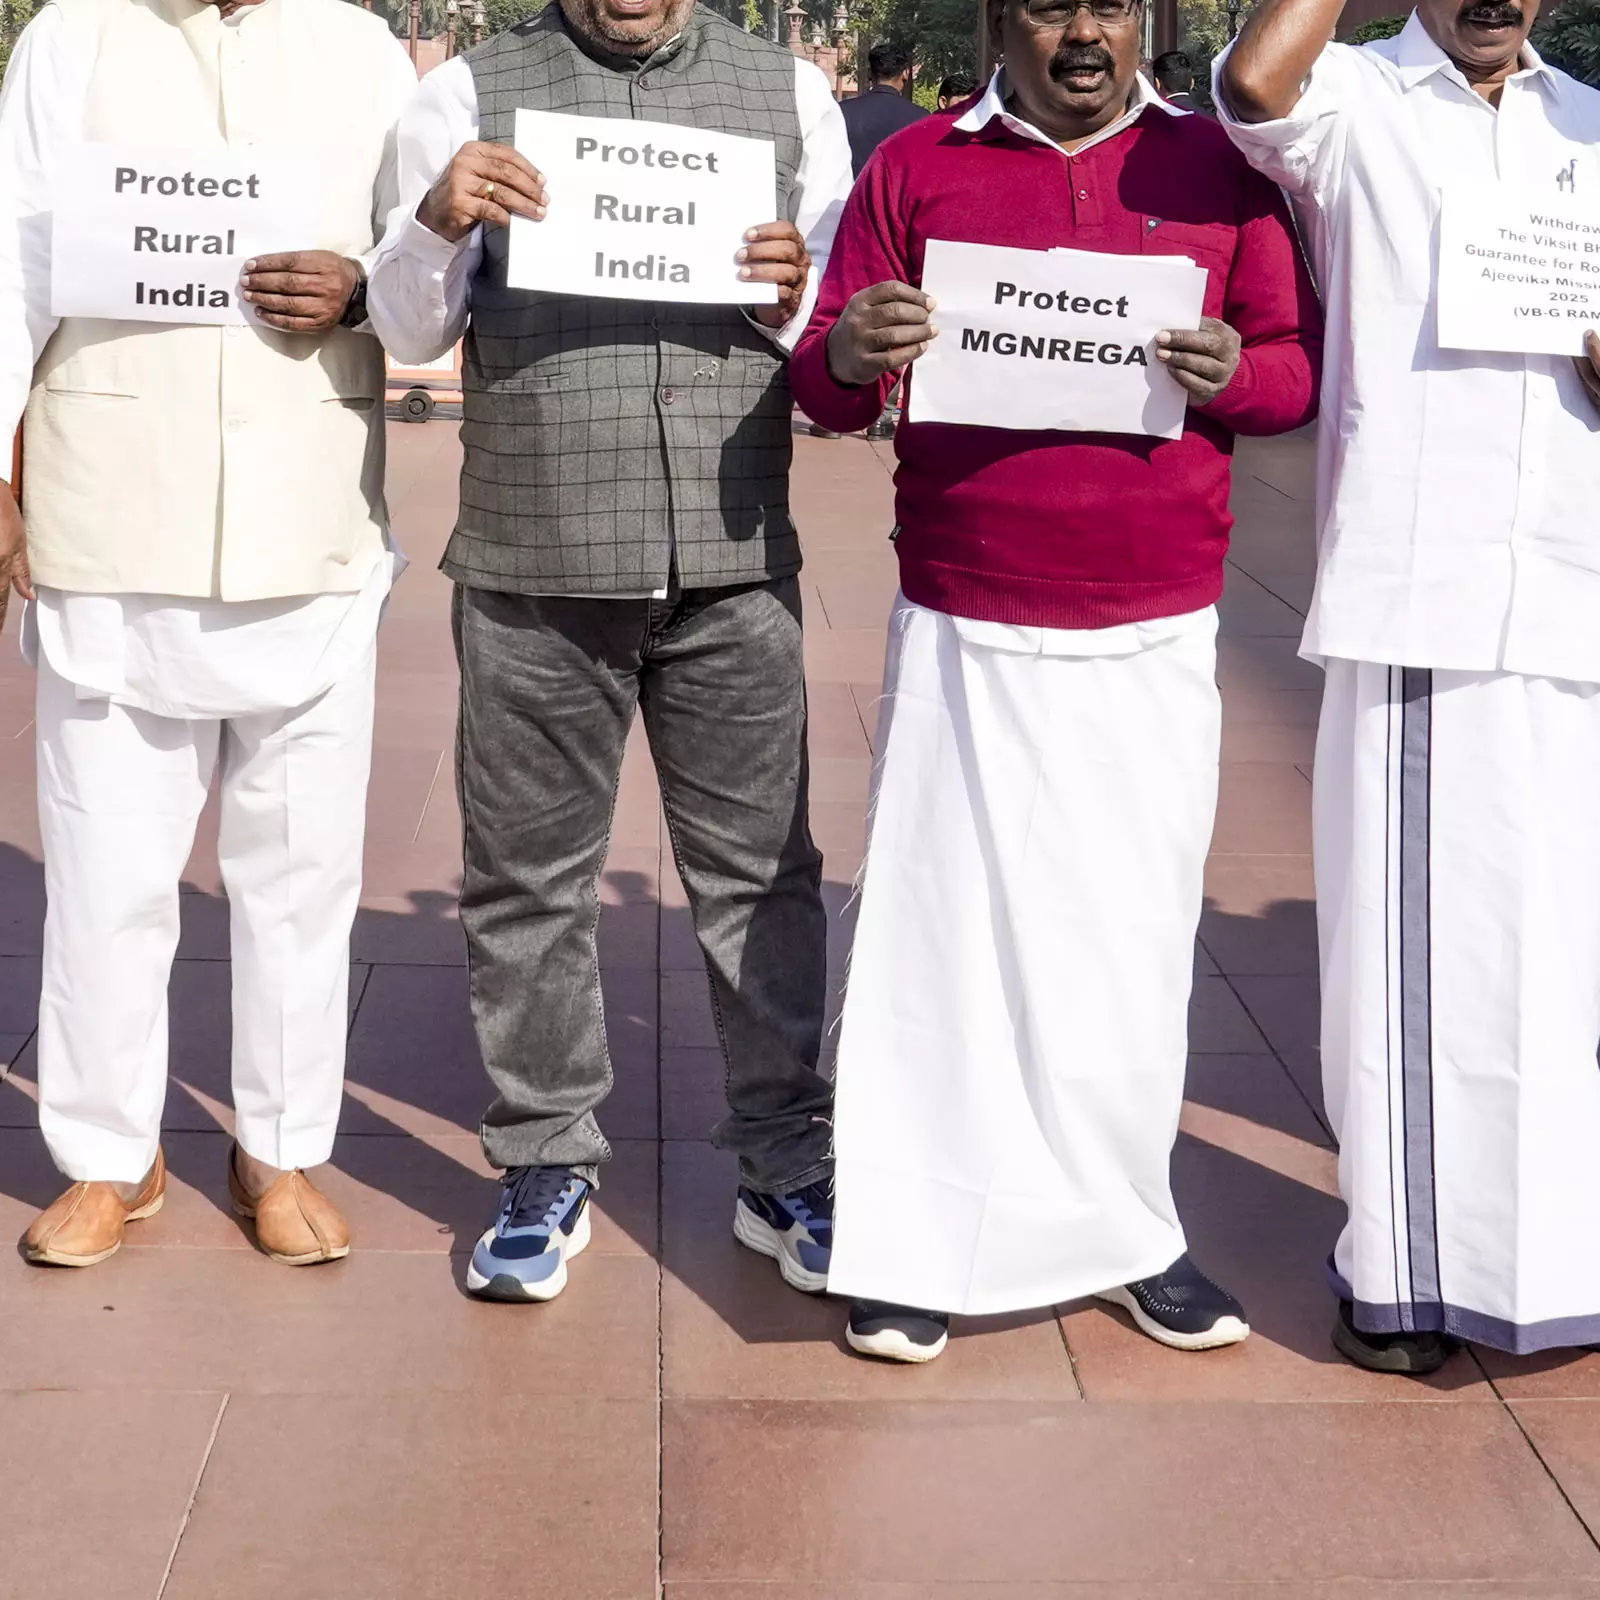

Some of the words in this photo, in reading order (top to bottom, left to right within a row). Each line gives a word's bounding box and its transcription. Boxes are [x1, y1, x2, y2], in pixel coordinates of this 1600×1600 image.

[576, 137, 718, 173] Protect
[115, 167, 260, 198] Protect
[594, 194, 695, 225] Rural
[134, 226, 235, 255] Rural
[1498, 228, 1527, 243] The
[1533, 234, 1577, 251] Viksit
[595, 252, 689, 283] India
[1465, 244, 1546, 266] Guarantee
[1553, 258, 1574, 270] for
[1481, 267, 1549, 284] Ajeevika
[136, 282, 229, 308] India
[995, 282, 1128, 317] Protect
[1549, 292, 1588, 303] 2025
[1514, 307, 1560, 317] (VB-G
[960, 327, 1148, 367] MGNREGA
